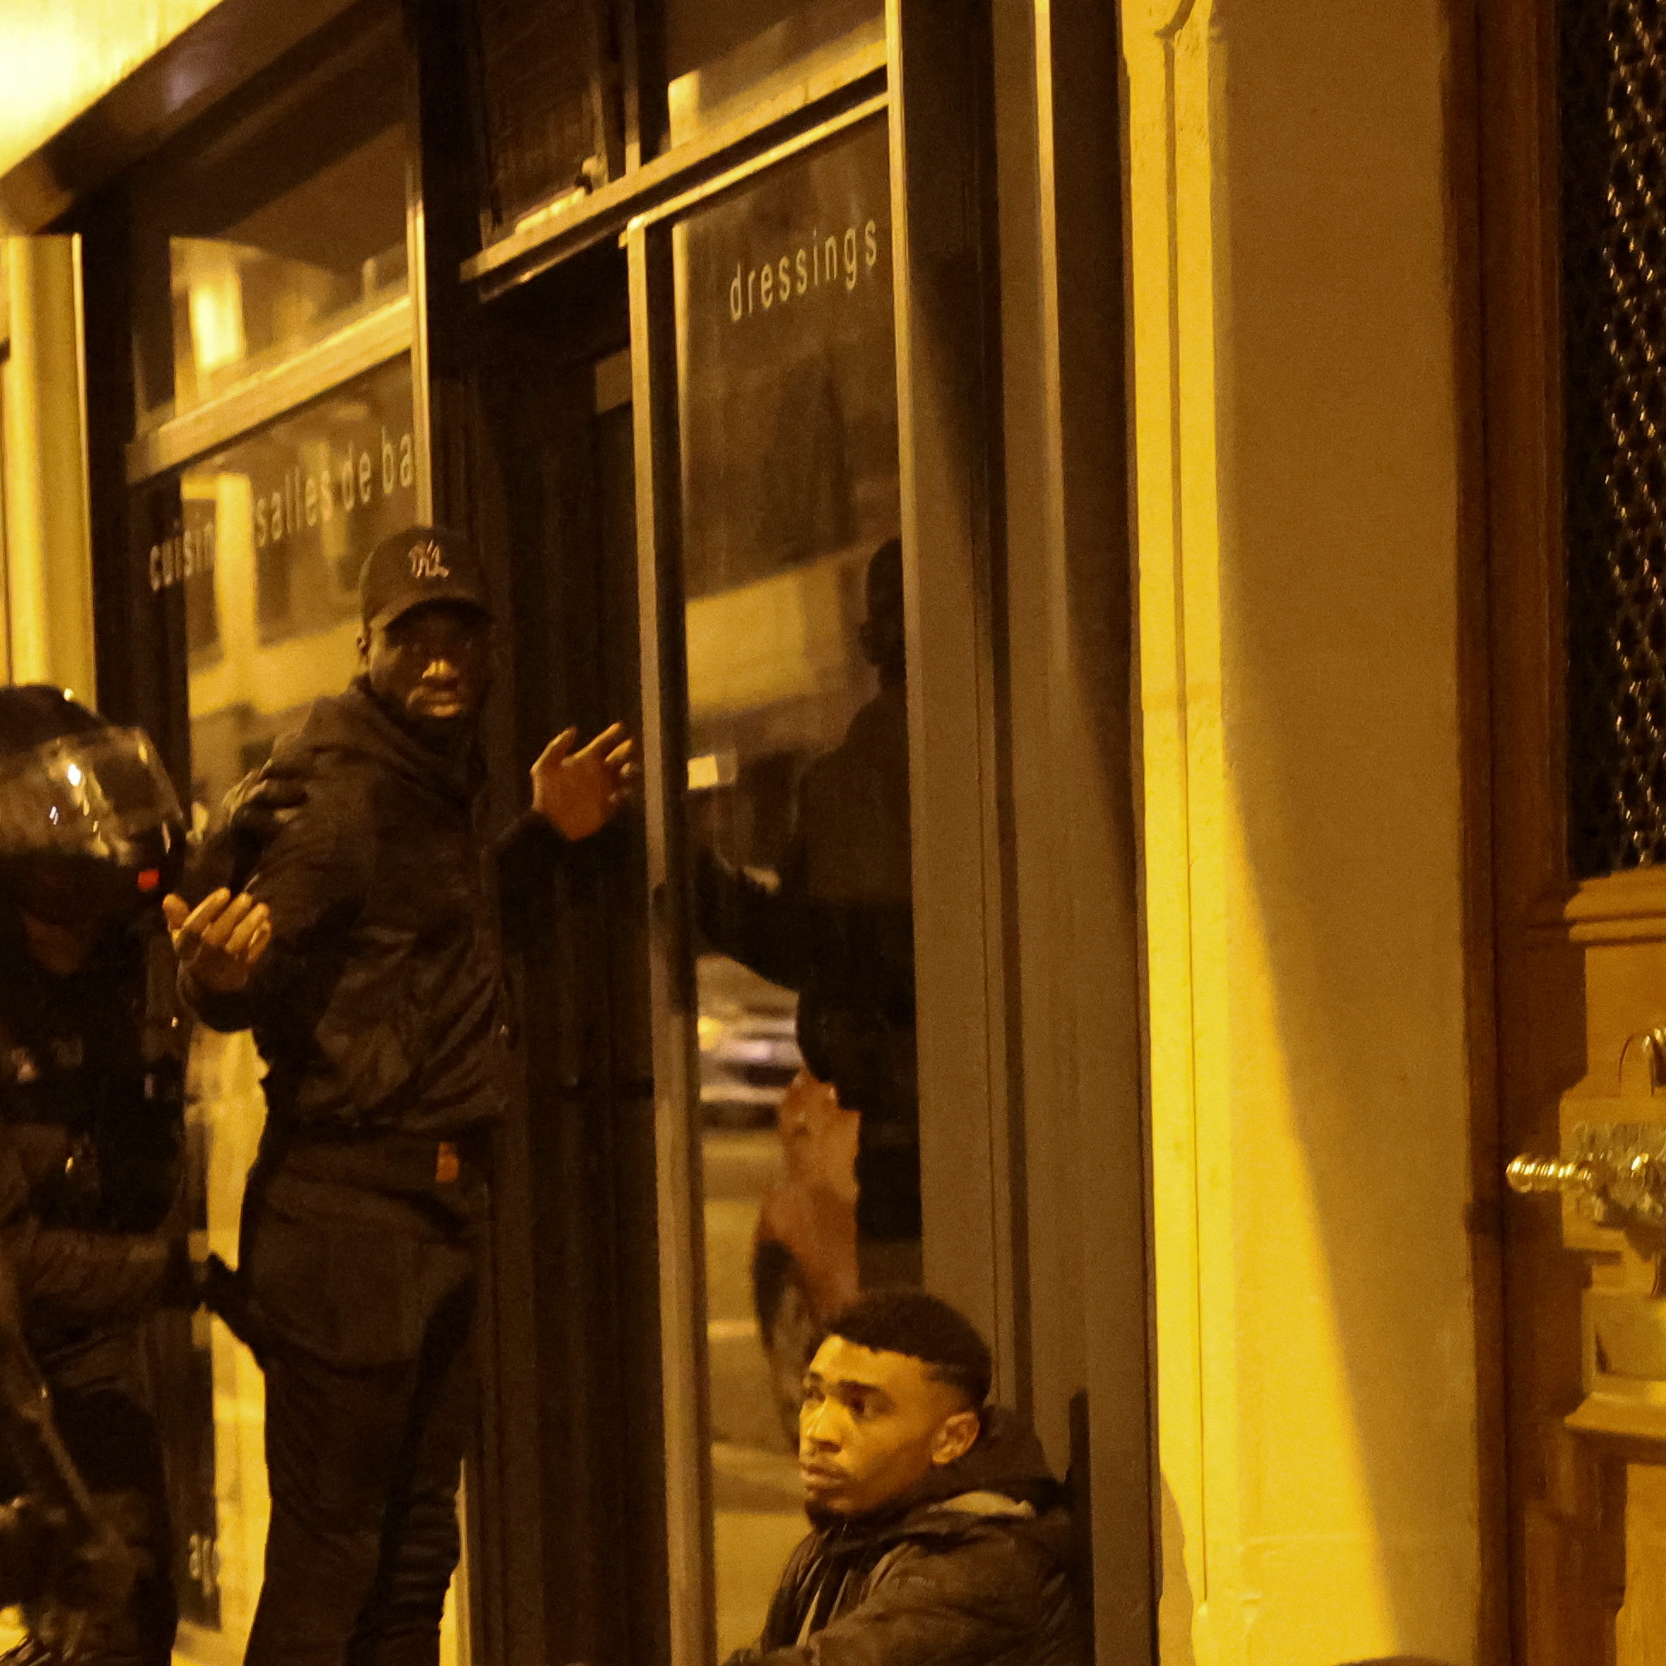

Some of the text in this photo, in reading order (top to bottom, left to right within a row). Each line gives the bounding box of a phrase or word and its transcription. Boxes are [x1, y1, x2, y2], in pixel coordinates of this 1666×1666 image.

[729, 219, 878, 323] dressings
[149, 424, 415, 592] cuisin salles de ba
